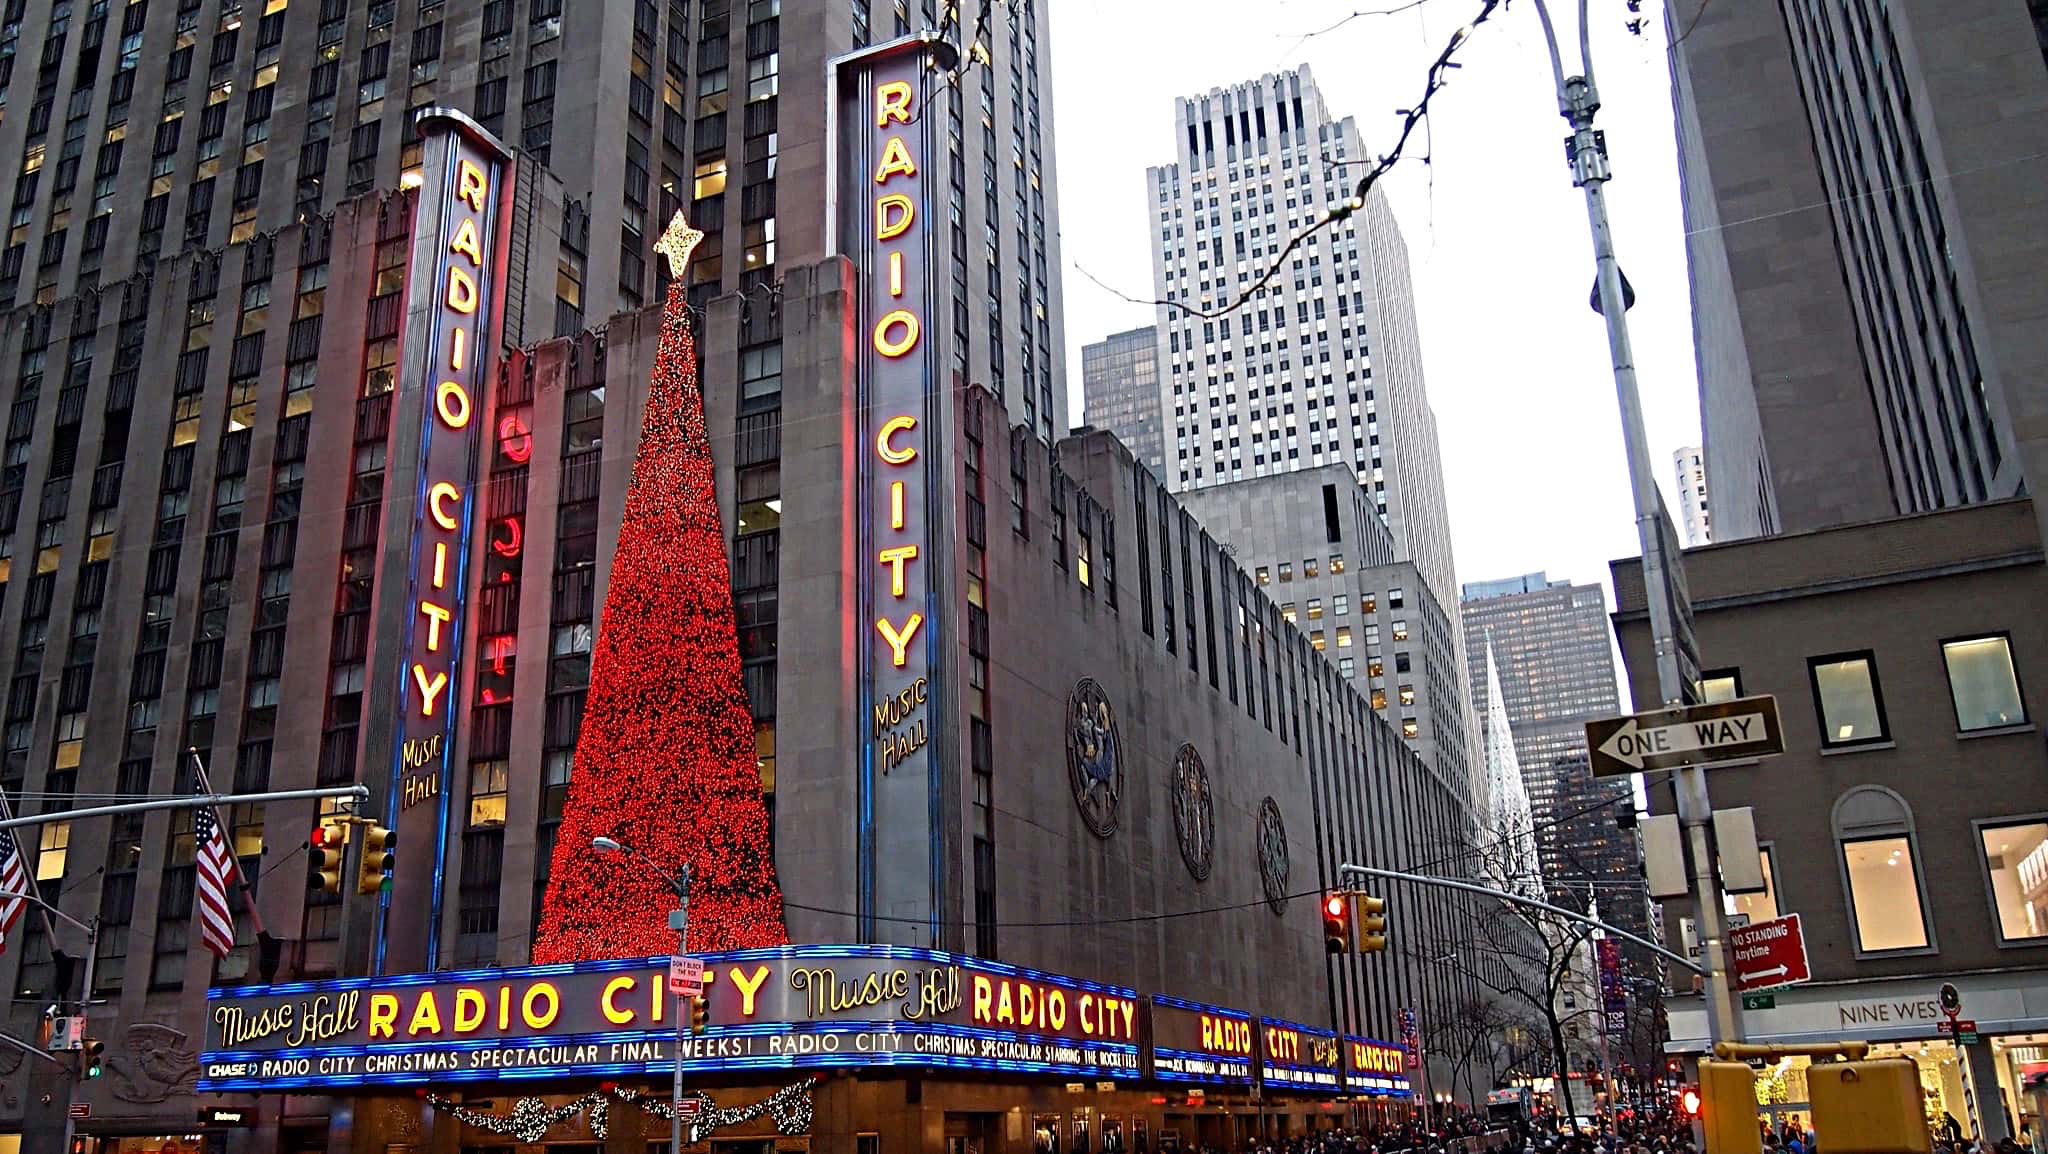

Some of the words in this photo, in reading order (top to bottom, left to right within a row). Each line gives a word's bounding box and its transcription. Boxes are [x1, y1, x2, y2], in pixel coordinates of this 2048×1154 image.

[873, 80, 921, 357] RADIO
[436, 158, 488, 429] RADIO
[877, 415, 923, 667] CITY
[412, 481, 460, 717] CITY
[874, 677, 927, 740] MUSIC
[402, 734, 441, 774] MUSIC
[880, 720, 928, 776] HALL
[1617, 729, 1671, 757] ONE
[1695, 717, 1752, 746] WAY
[402, 771, 439, 810] HALL
[1731, 934, 1744, 946] NO
[1745, 923, 1788, 944] STANDING
[1735, 945, 1770, 961] Anytime
[214, 1006, 292, 1048] Music
[286, 989, 360, 1046] Hall
[368, 981, 561, 1039] RADIO
[601, 966, 770, 1024] CIY
[790, 967, 909, 1018] Music
[903, 966, 962, 1020] Hall
[973, 975, 1067, 1031] RADIO
[1079, 994, 1134, 1039] CITY
[1607, 1011, 1625, 1020] TOP
[1840, 1004, 1889, 1025] NINE
[1893, 1000, 1938, 1019] WES
[208, 1063, 247, 1078] CHASE
[262, 1058, 310, 1077] RADIO
[319, 1056, 355, 1074] CITY
[365, 1052, 459, 1074] CHRISTMAS
[469, 1044, 598, 1068] SPECTACULAR
[610, 1041, 664, 1063] FINAL
[769, 1034, 840, 1054] RADIO
[856, 1033, 901, 1052] CITY
[914, 1033, 976, 1056] CHRISTMAS
[981, 1039, 1042, 1061] SPECTACULAR
[1045, 1046, 1081, 1066] STARRING
[1084, 1050, 1097, 1066] THE
[1201, 1015, 1250, 1054] RADIO
[1268, 1027, 1298, 1060] CITY
